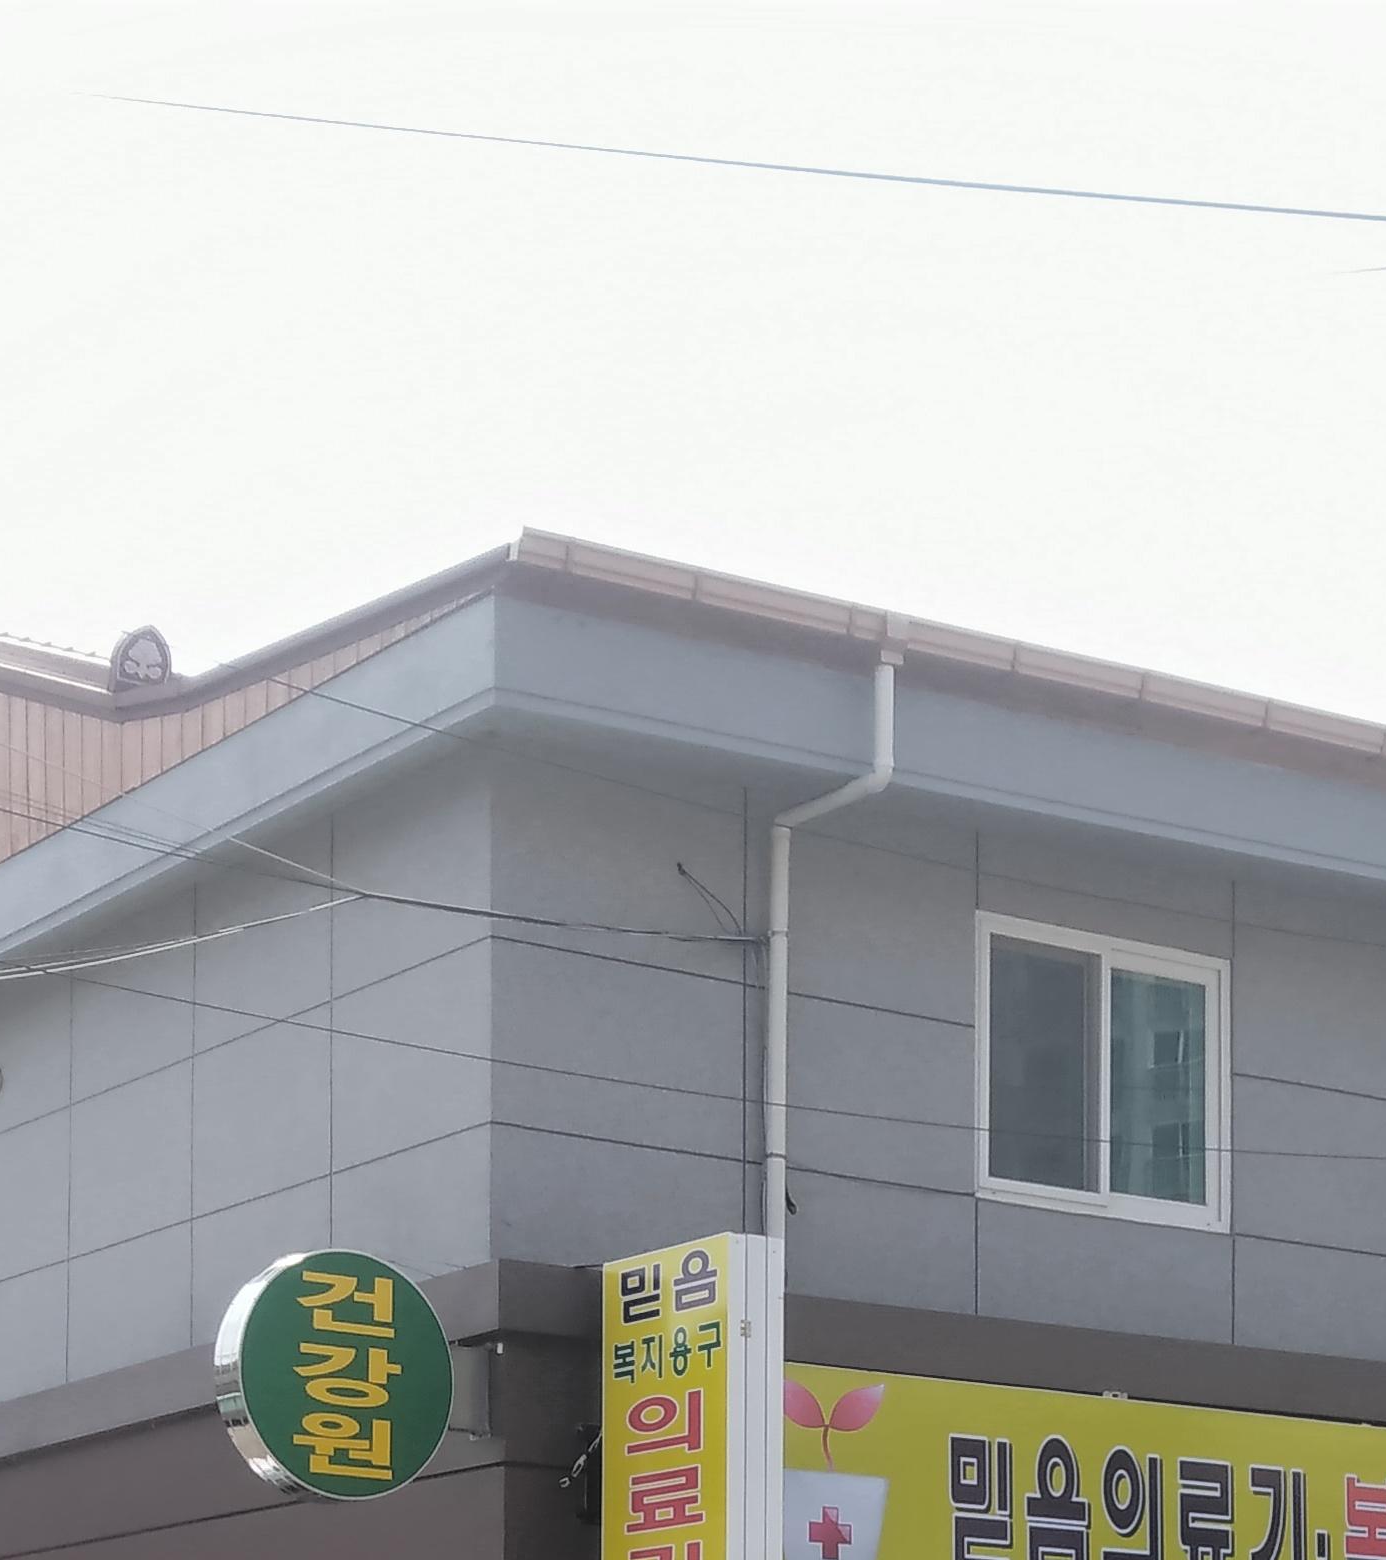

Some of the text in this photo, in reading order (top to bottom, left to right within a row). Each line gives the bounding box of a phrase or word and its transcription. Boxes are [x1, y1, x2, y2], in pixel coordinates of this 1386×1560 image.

[619, 1247, 718, 1325] 믿음
[292, 1269, 403, 1482] 건강원
[612, 1320, 724, 1384] 복지용구
